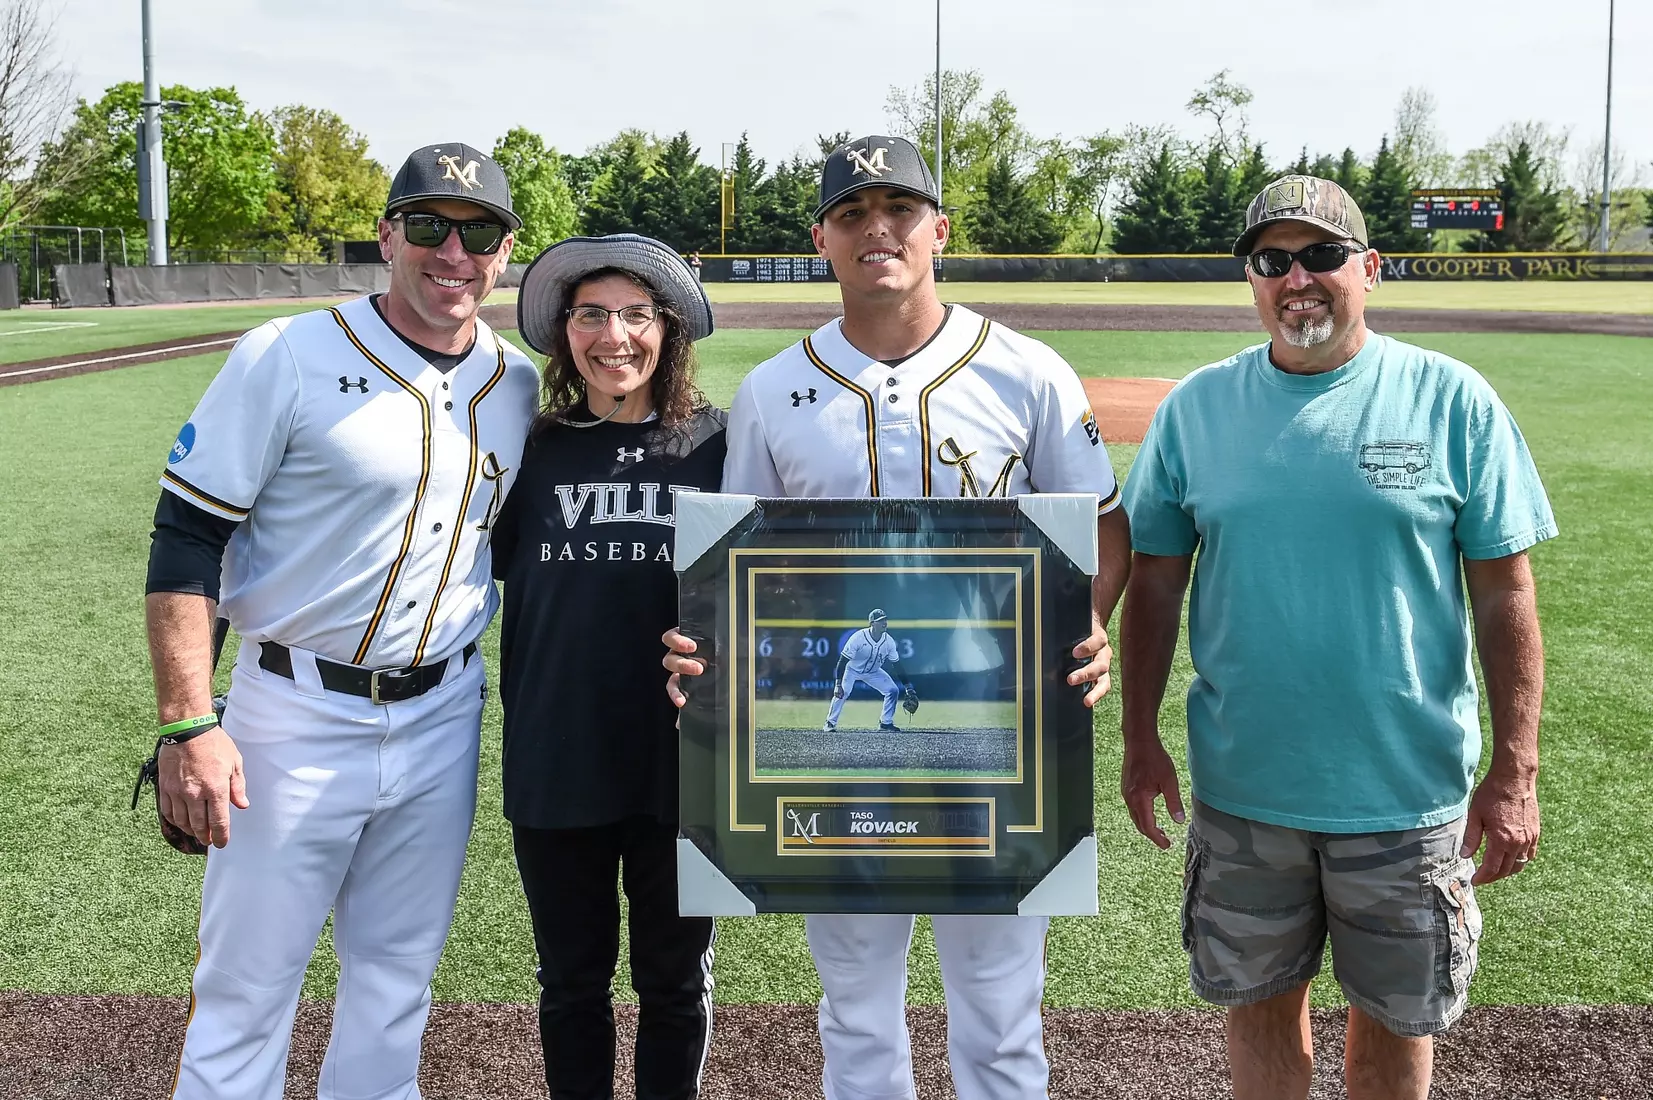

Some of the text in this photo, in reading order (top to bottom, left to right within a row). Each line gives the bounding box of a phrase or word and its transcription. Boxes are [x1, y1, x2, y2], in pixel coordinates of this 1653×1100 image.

[1412, 258, 1601, 280] COOPER PARK
[1365, 472, 1427, 487] THE SIMPLE LIFE
[555, 483, 701, 529] VILL
[540, 542, 673, 562] BASEBA
[850, 811, 874, 820] TASO
[850, 821, 919, 834] KOVACK
